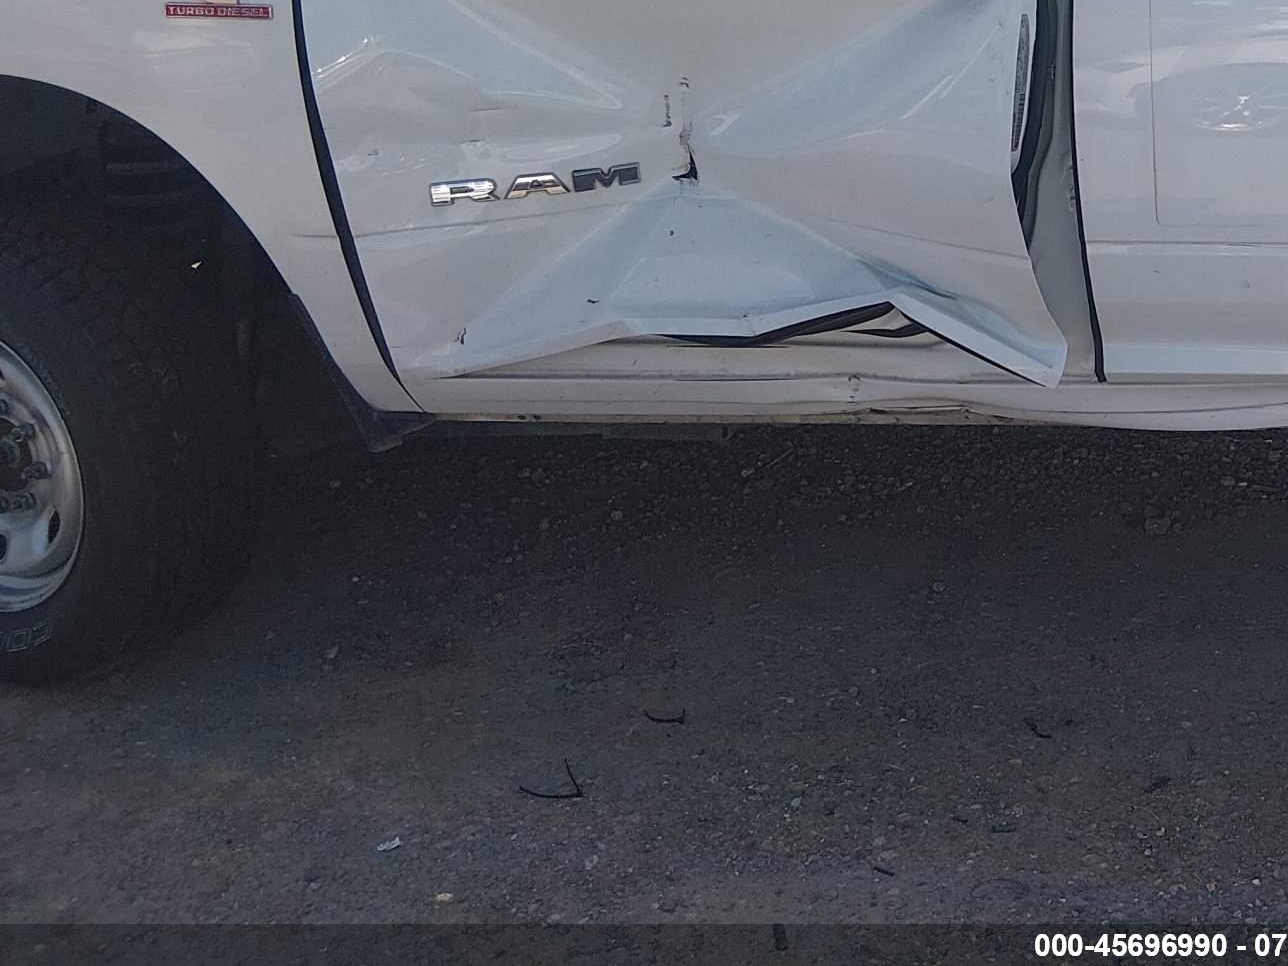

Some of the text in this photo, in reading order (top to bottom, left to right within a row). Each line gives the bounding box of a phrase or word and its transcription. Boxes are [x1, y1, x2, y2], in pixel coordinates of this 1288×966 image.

[167, 5, 269, 17] TURBO DIESEL
[429, 161, 642, 208] RAM
